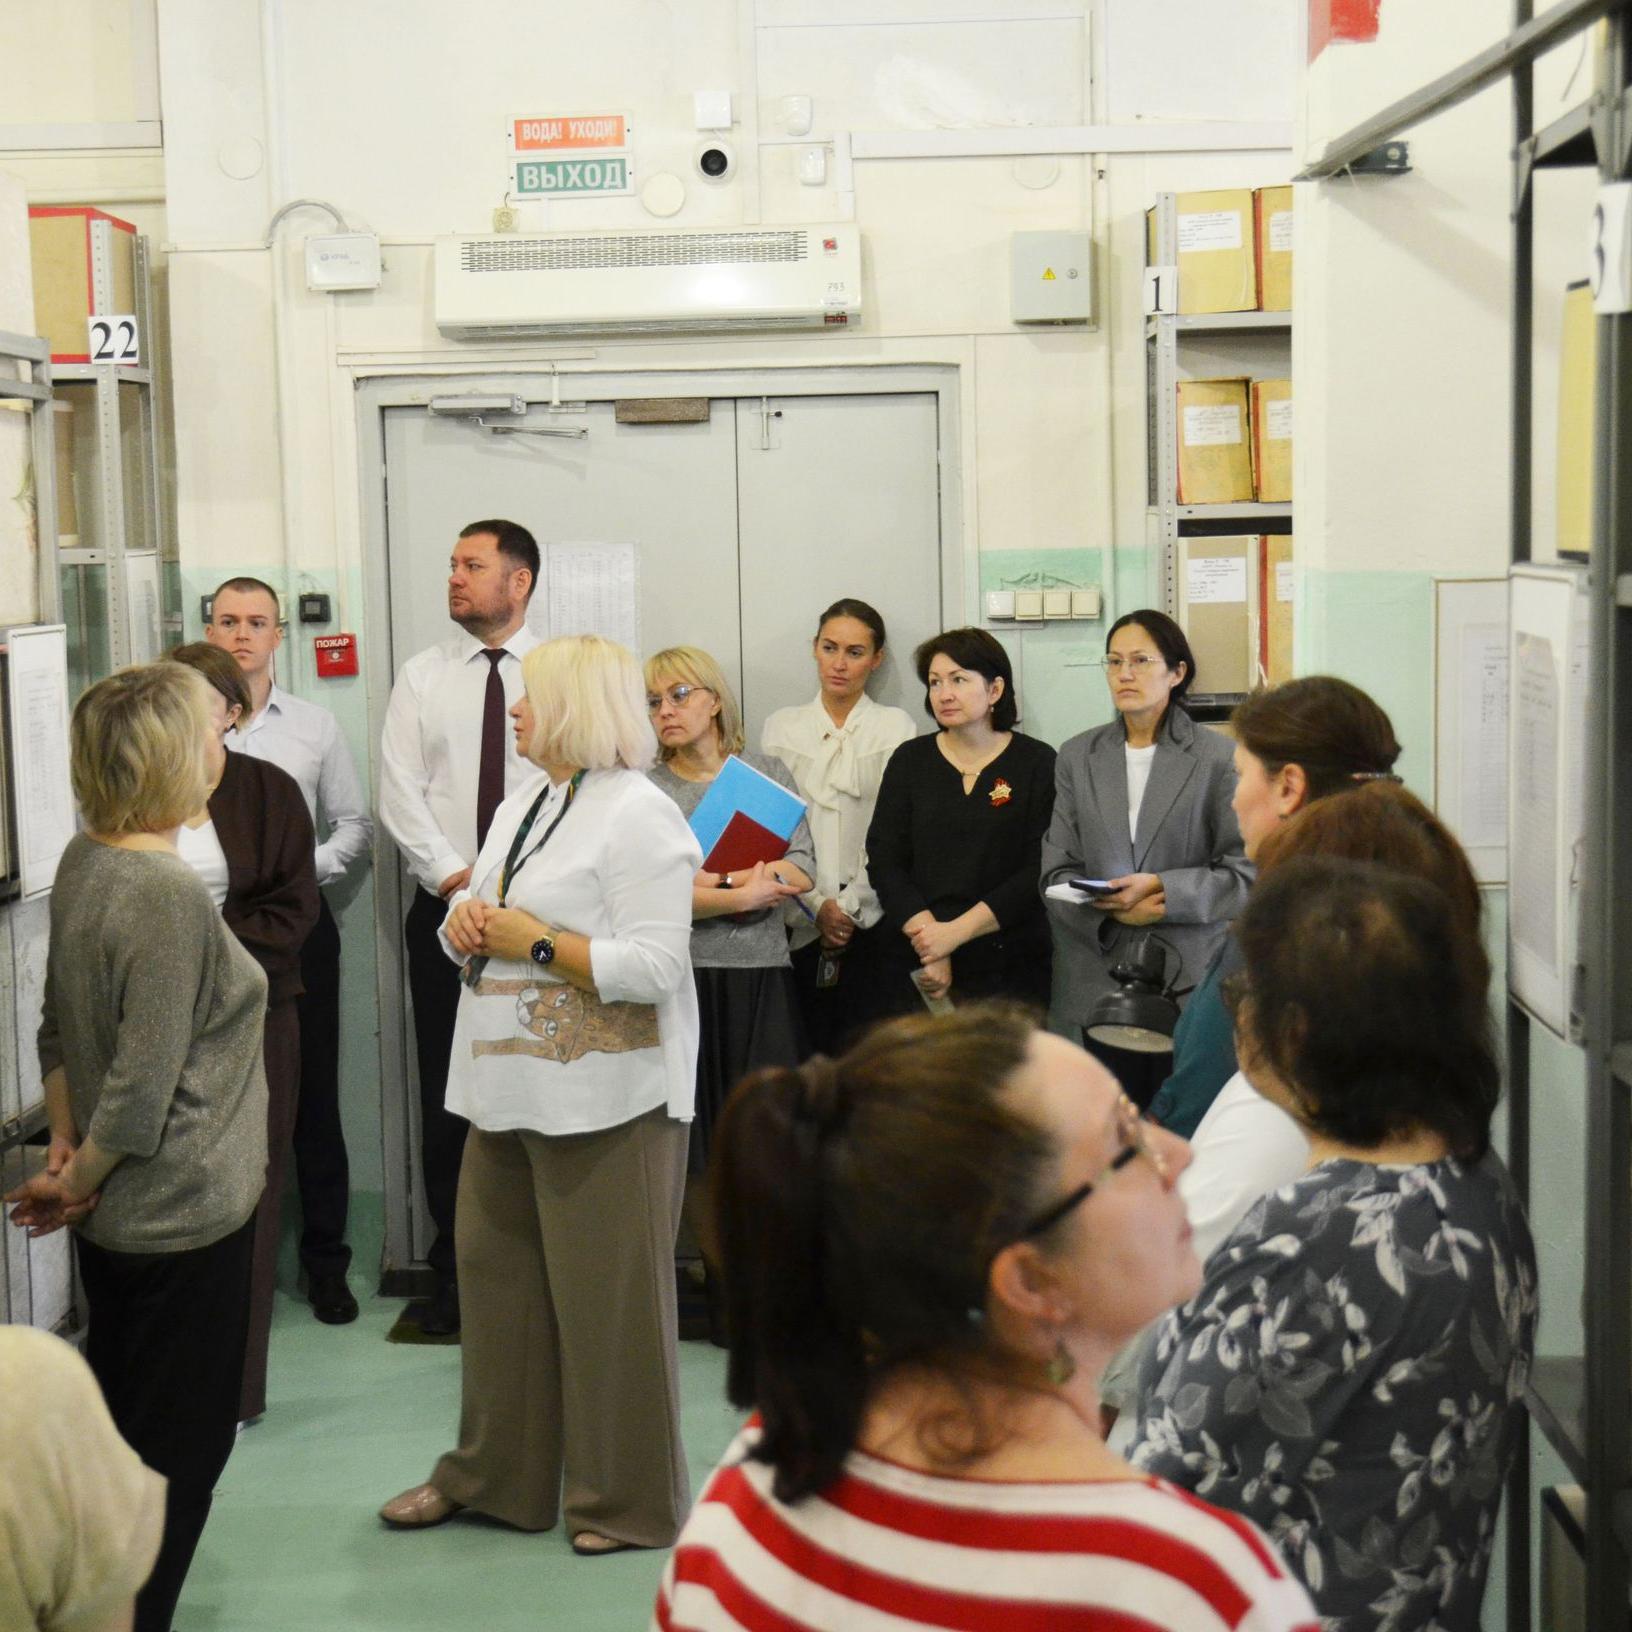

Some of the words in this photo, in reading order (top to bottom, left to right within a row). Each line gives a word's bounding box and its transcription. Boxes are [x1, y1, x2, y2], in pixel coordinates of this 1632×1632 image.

[522, 121, 563, 143] ВОДА!
[569, 119, 617, 141] УХОДИ!
[522, 162, 623, 190] ВЫХОД
[1152, 275, 1164, 312] 1
[91, 320, 138, 359] 22
[316, 638, 349, 648] ПОЖАР
